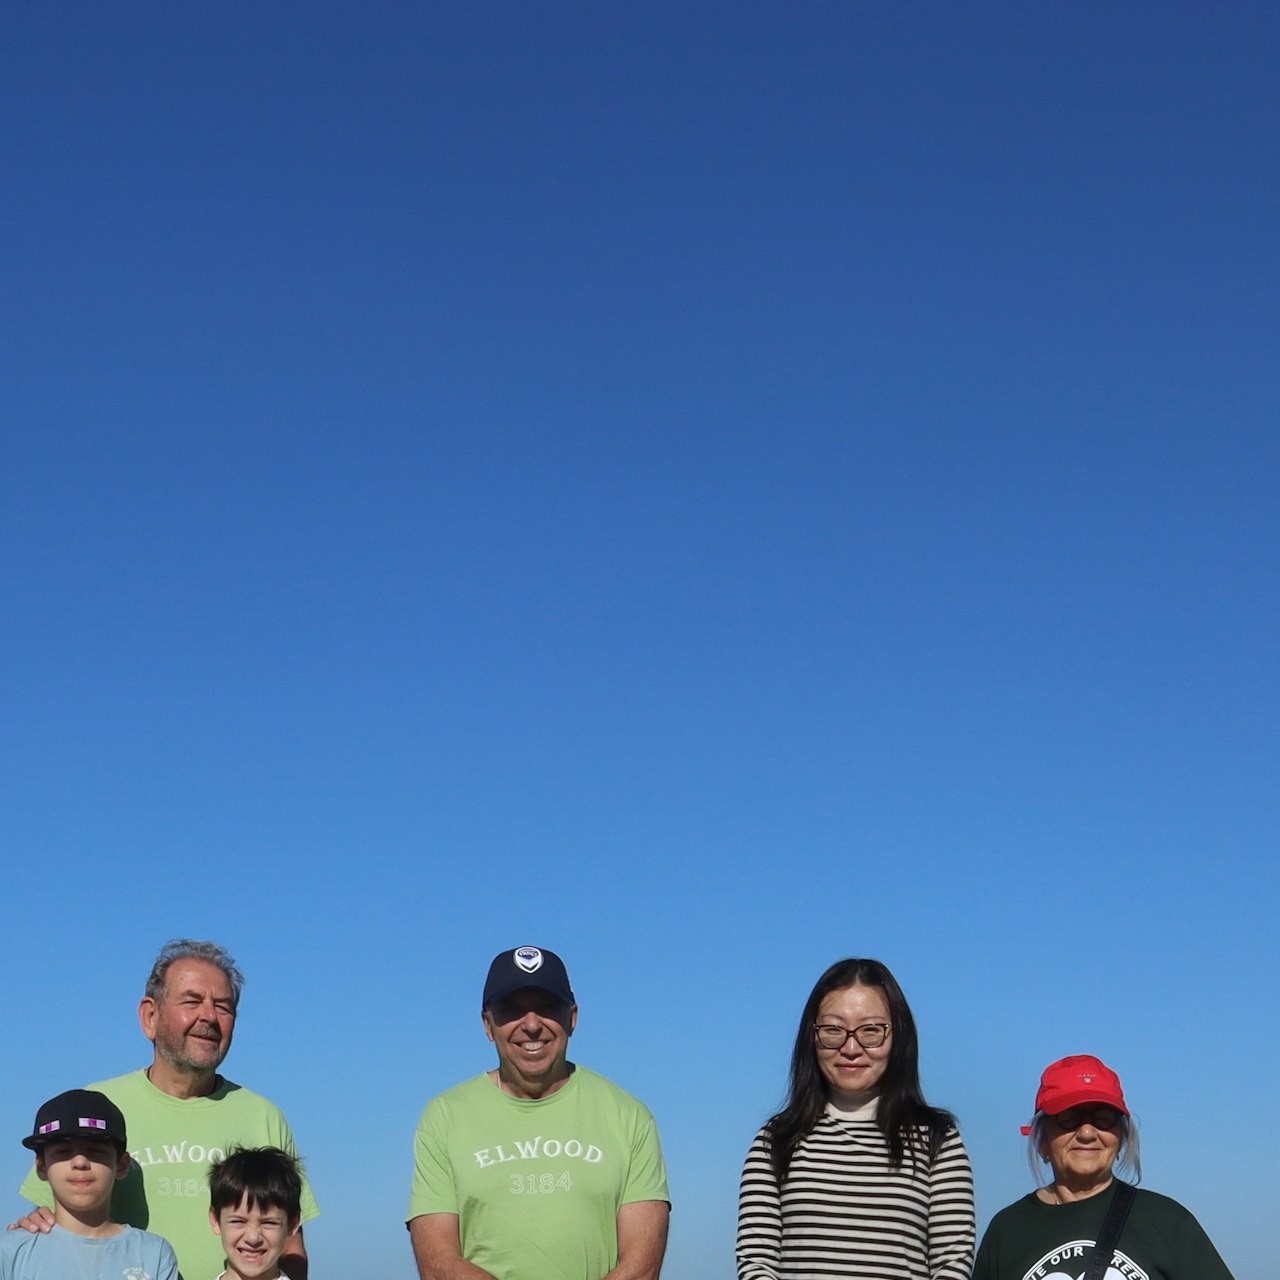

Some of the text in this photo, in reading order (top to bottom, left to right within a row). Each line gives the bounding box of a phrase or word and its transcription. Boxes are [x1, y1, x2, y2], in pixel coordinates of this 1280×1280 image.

[473, 1136, 603, 1168] ELWOOD
[509, 1170, 573, 1194] 3184
[1050, 1246, 1084, 1265] OUR
